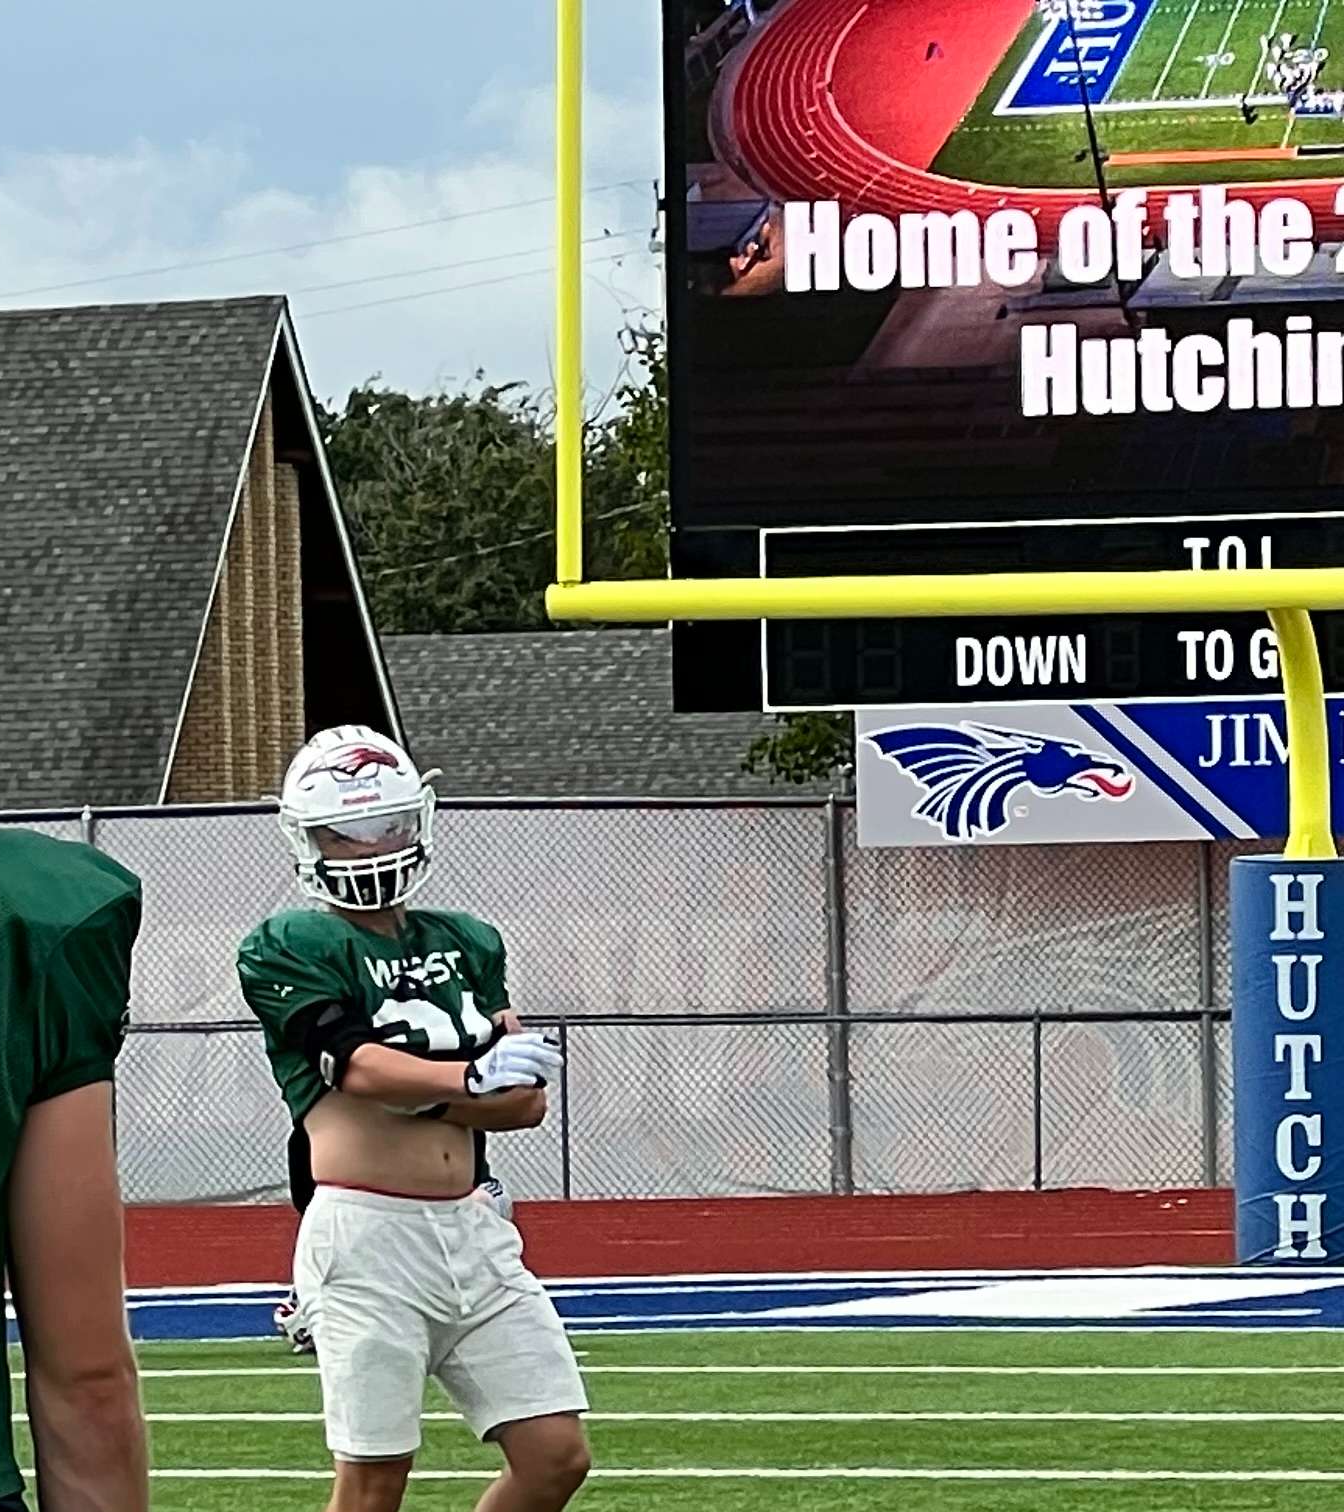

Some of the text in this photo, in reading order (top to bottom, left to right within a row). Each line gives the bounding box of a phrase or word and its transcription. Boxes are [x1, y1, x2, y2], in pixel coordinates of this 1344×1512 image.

[784, 200, 1039, 291] Home
[1059, 197, 1148, 284] of
[1164, 185, 1314, 279] the
[955, 635, 1088, 686] DOWN
[1177, 628, 1280, 680] TO G
[1268, 873, 1327, 1259] HUTCH
